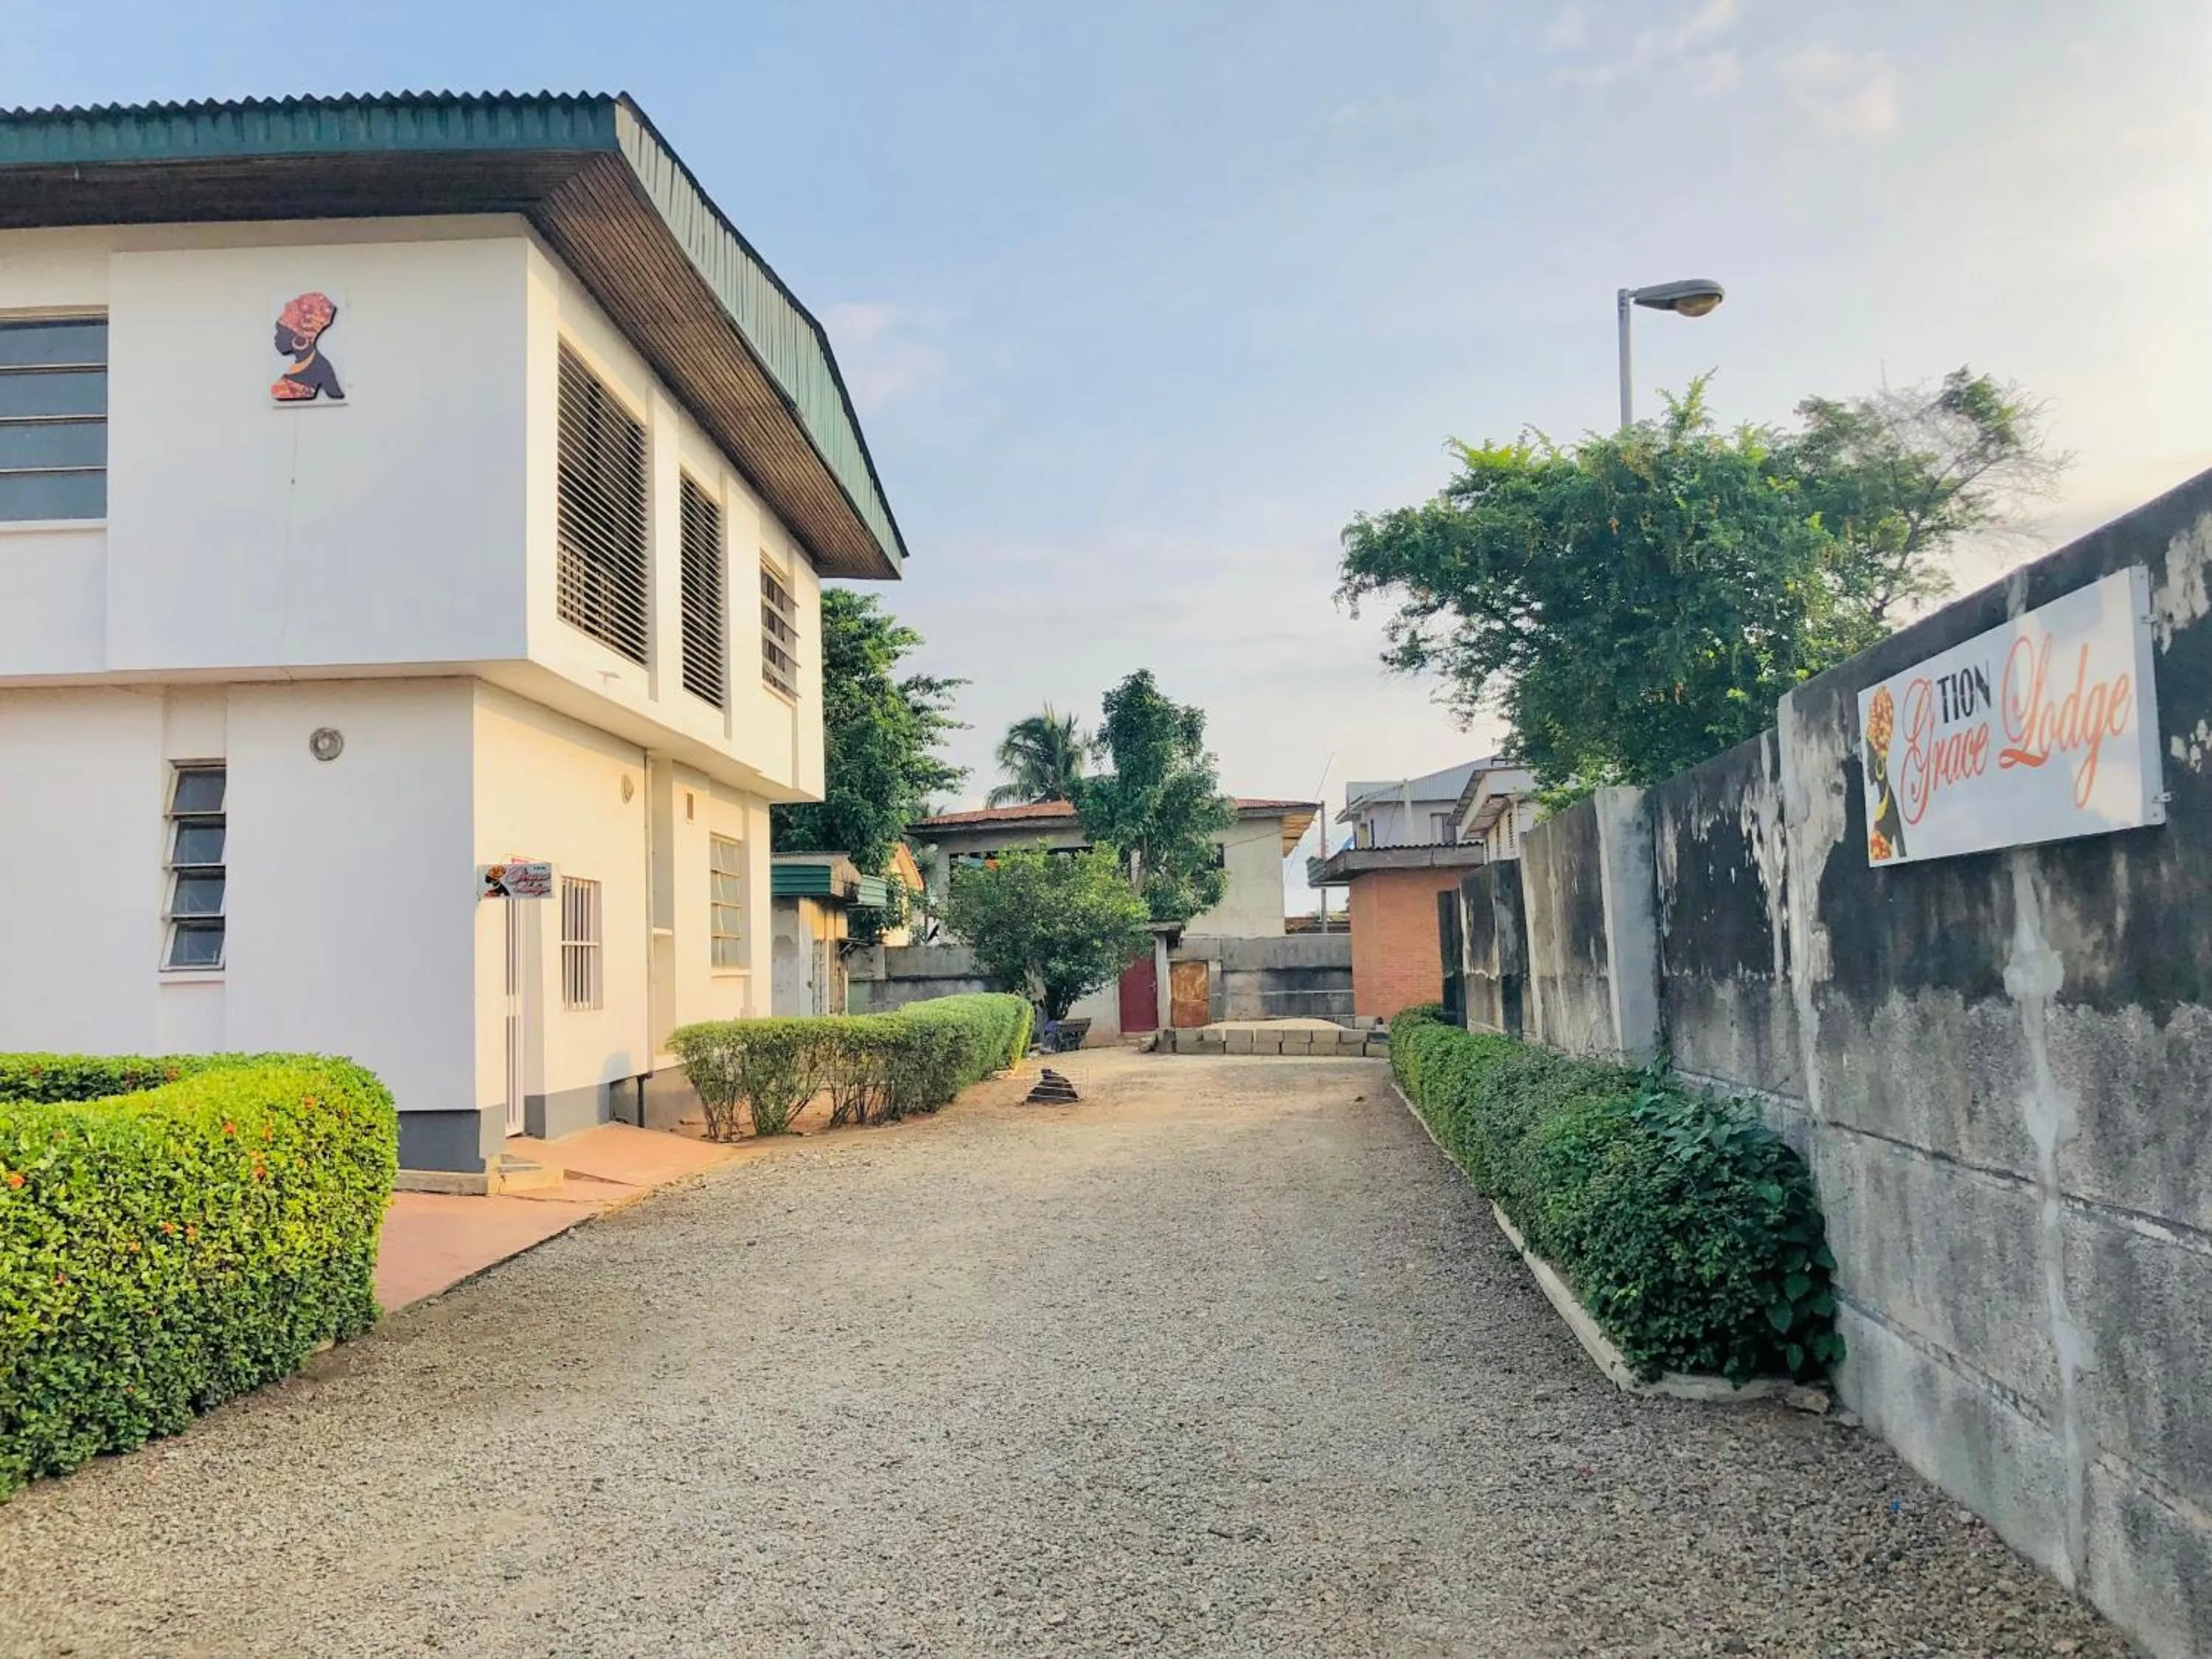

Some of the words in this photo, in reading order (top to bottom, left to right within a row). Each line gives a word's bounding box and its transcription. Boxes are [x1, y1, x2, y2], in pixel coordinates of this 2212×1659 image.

[1899, 678, 1989, 826] Grace
[1998, 632, 2132, 810] Lodge
[1938, 661, 1992, 724] TION
